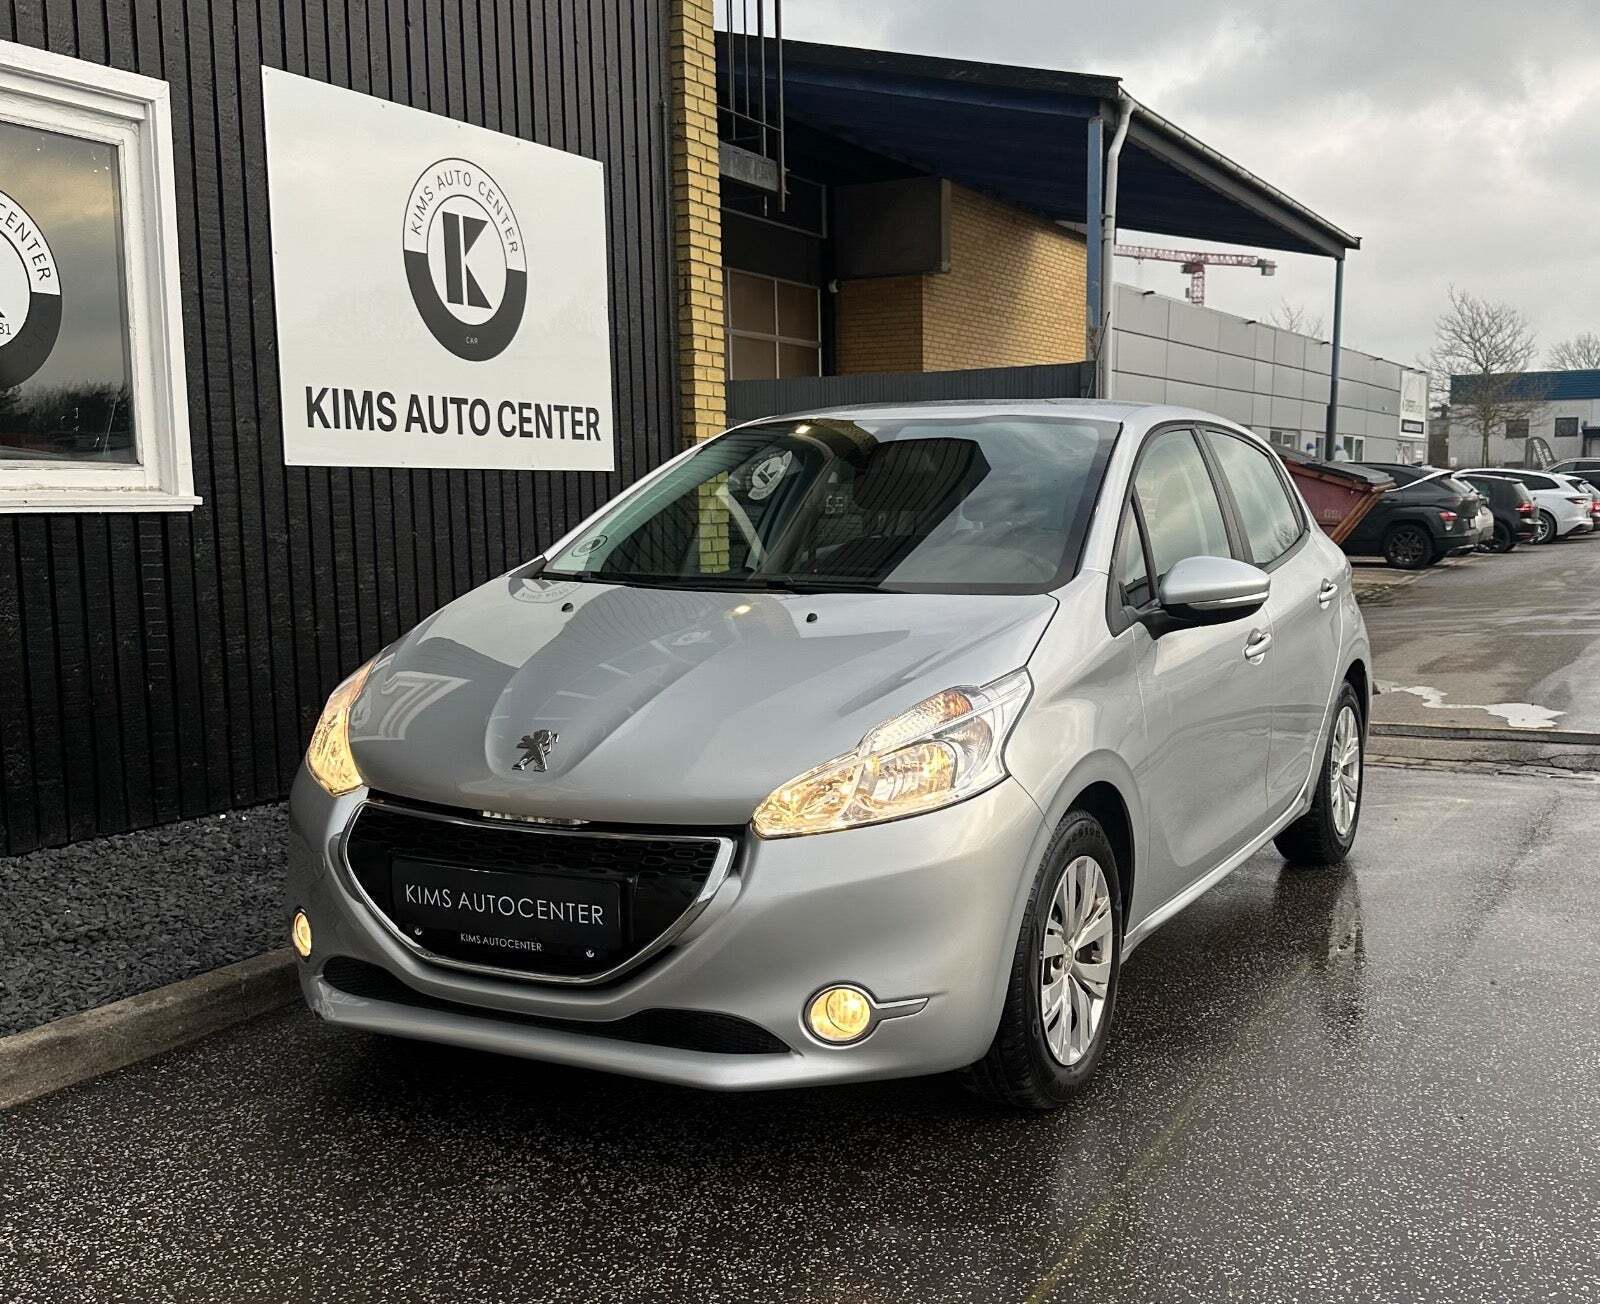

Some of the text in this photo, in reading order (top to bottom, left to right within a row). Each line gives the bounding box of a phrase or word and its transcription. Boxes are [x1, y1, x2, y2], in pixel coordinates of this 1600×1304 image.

[411, 170, 518, 253] KIMS AUTO CENTER
[305, 386, 602, 441] KIMS AUTO CENTER
[405, 883, 604, 926] KIMS AUTOCENTER
[460, 932, 542, 952] KIMS AUTOCENTER
